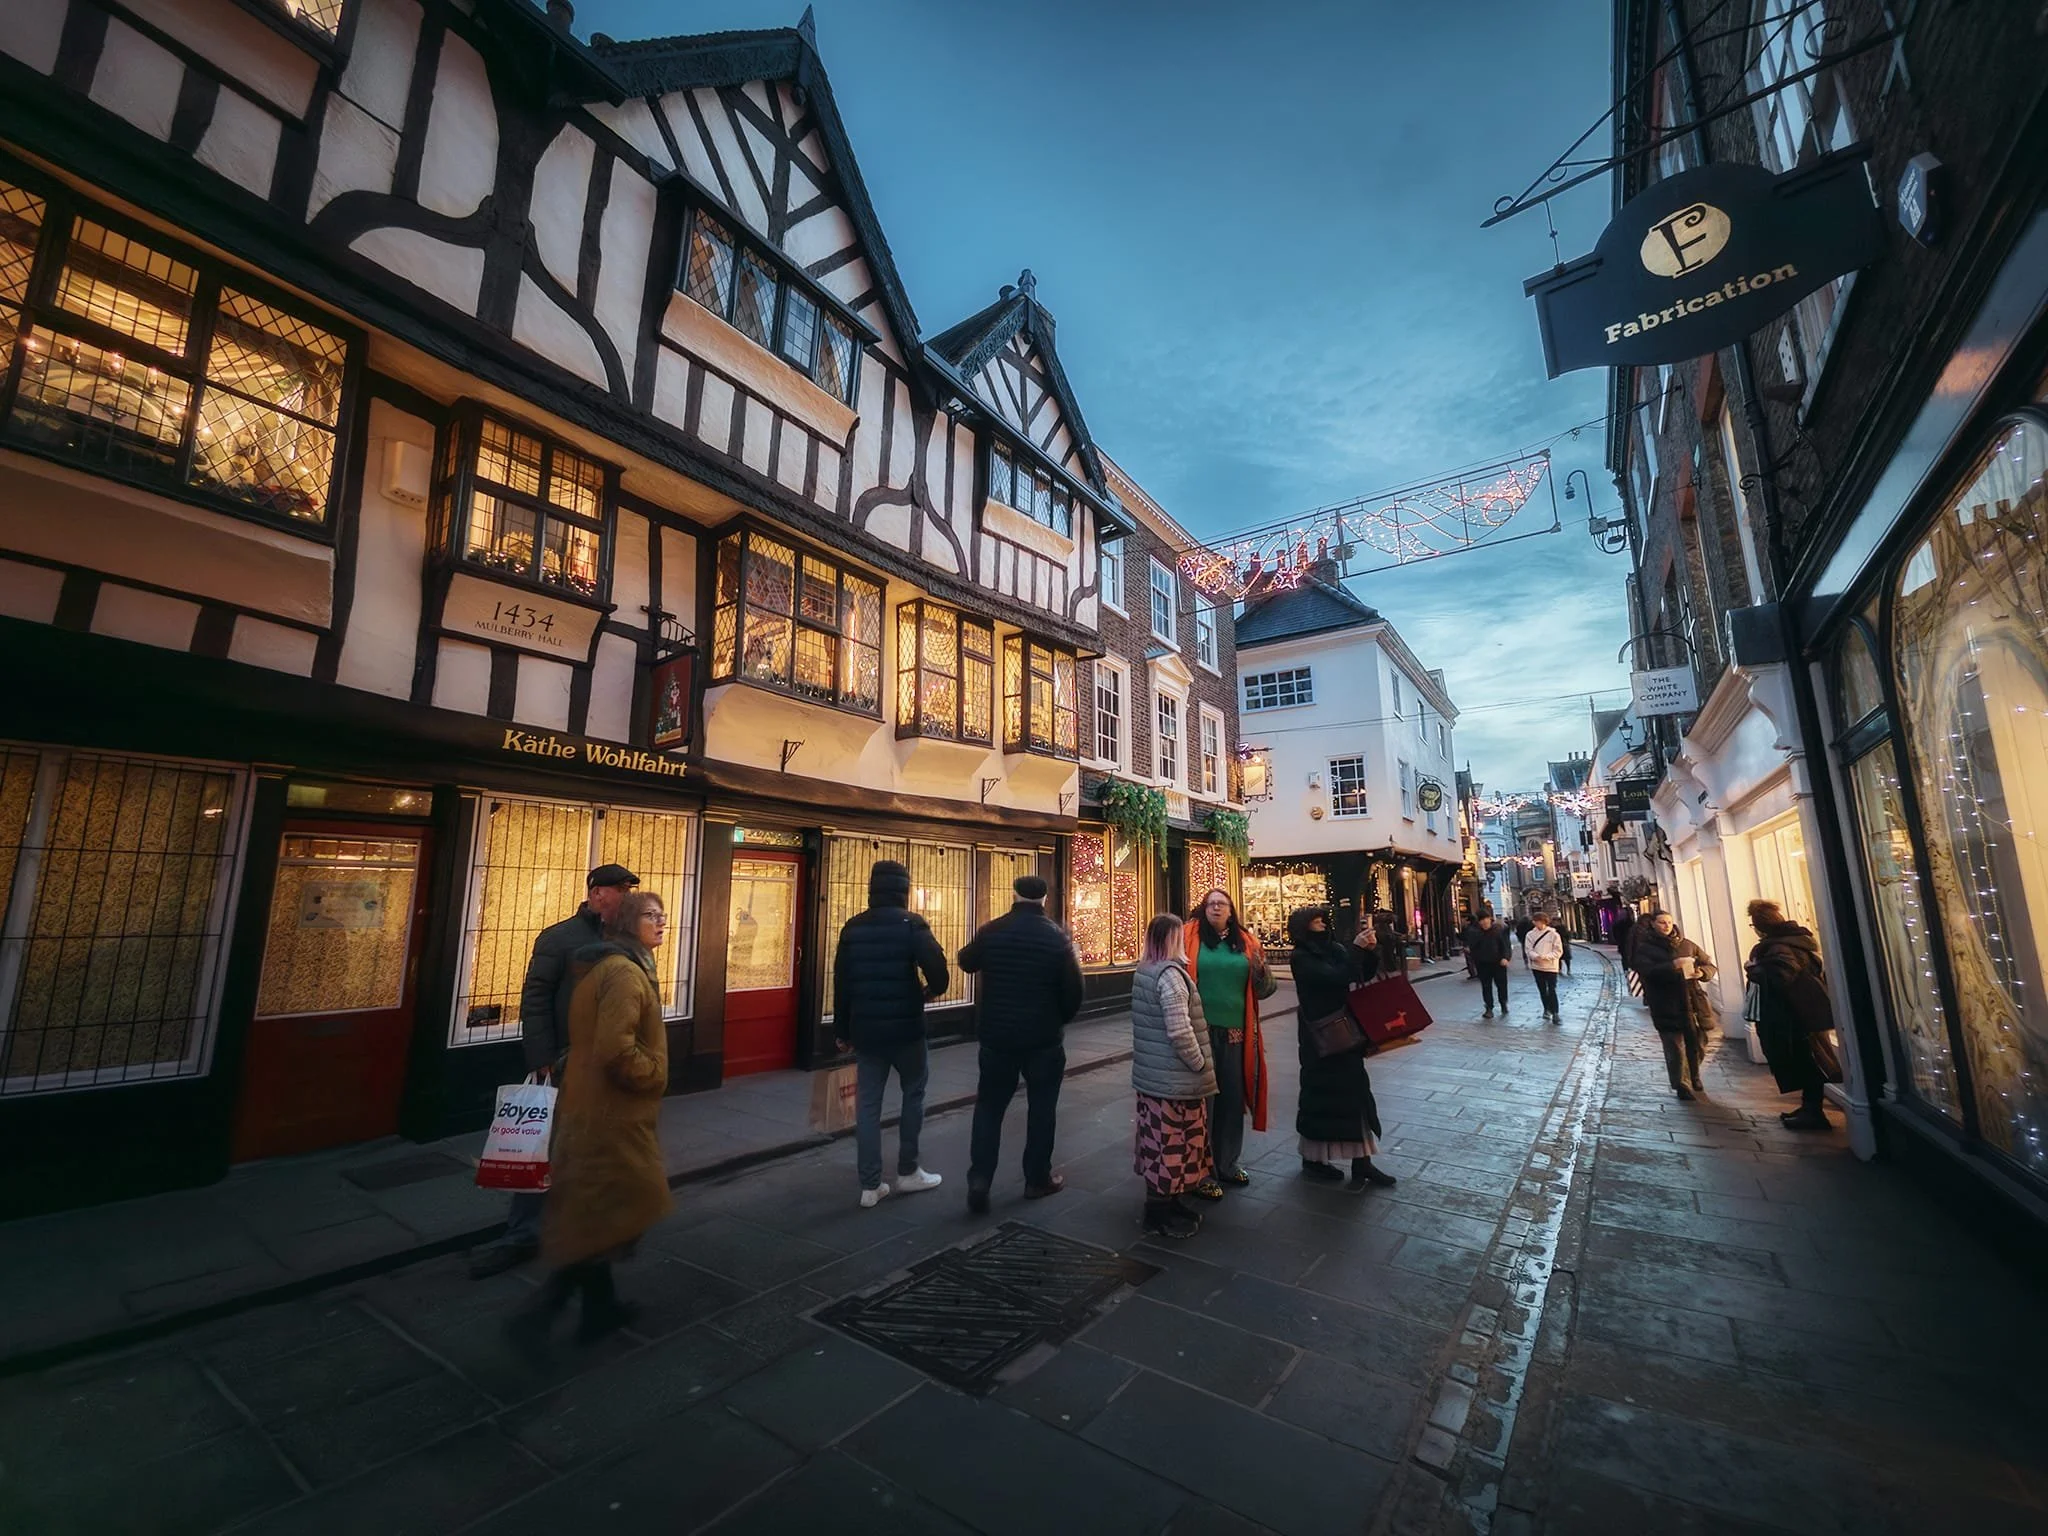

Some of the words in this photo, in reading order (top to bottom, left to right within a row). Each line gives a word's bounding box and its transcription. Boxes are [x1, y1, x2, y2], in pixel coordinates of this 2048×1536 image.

[1604, 262, 1799, 345] Fabrication
[494, 601, 554, 632] 1434
[475, 621, 534, 640] MULBERRY
[538, 634, 563, 647] HALL
[1640, 690, 1687, 701] COMPANY
[1647, 683, 1678, 692] WHITE
[502, 729, 577, 759] Käthe
[585, 743, 688, 777] Wohlfahrt
[498, 1102, 549, 1125] Boyes
[500, 1127, 521, 1136] good
[522, 1127, 542, 1135] value
